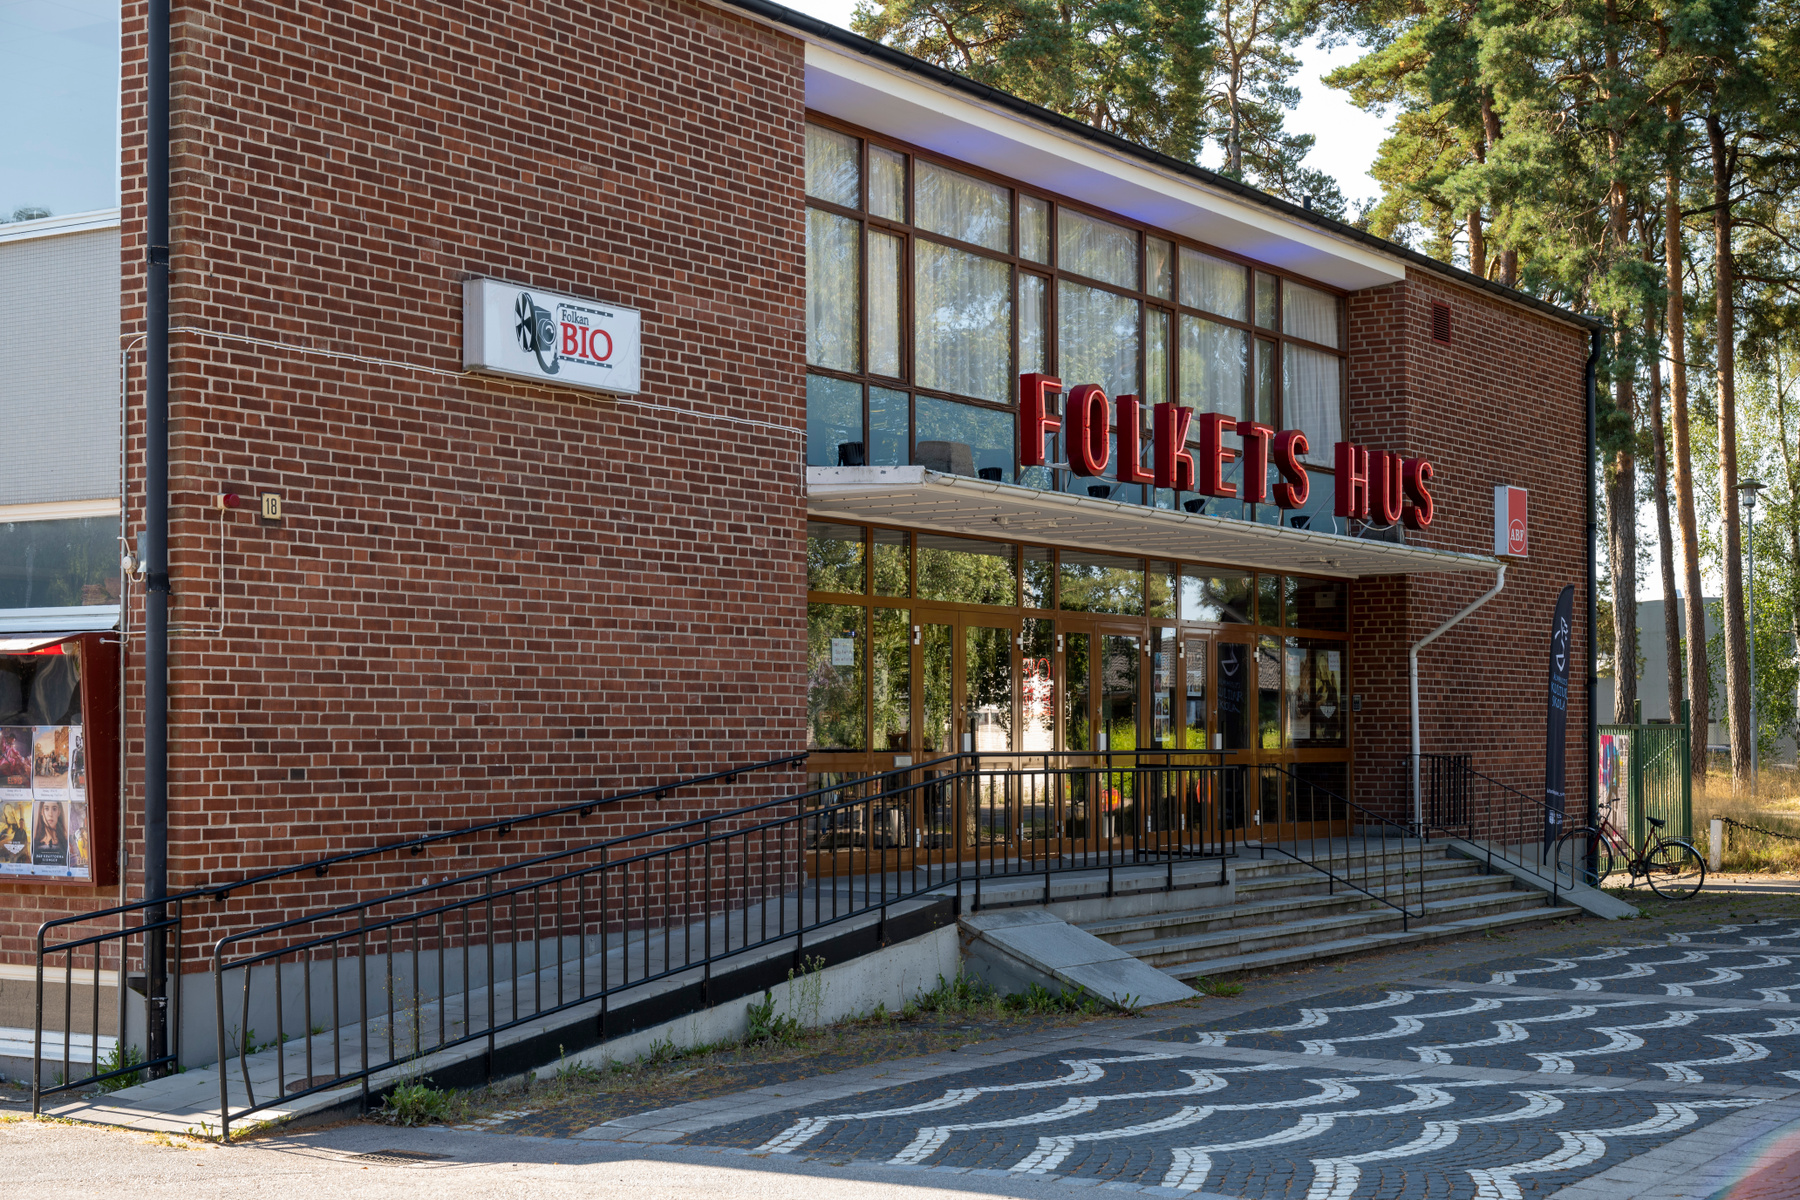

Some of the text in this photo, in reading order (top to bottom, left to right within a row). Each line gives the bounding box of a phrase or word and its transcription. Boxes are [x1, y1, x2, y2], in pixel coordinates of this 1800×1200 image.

[562, 309, 590, 325] Folkan
[560, 321, 613, 361] BIO
[1019, 372, 1434, 531] FOLKETS HUS
[265, 497, 277, 515] 18
[1510, 528, 1525, 542] ABF
